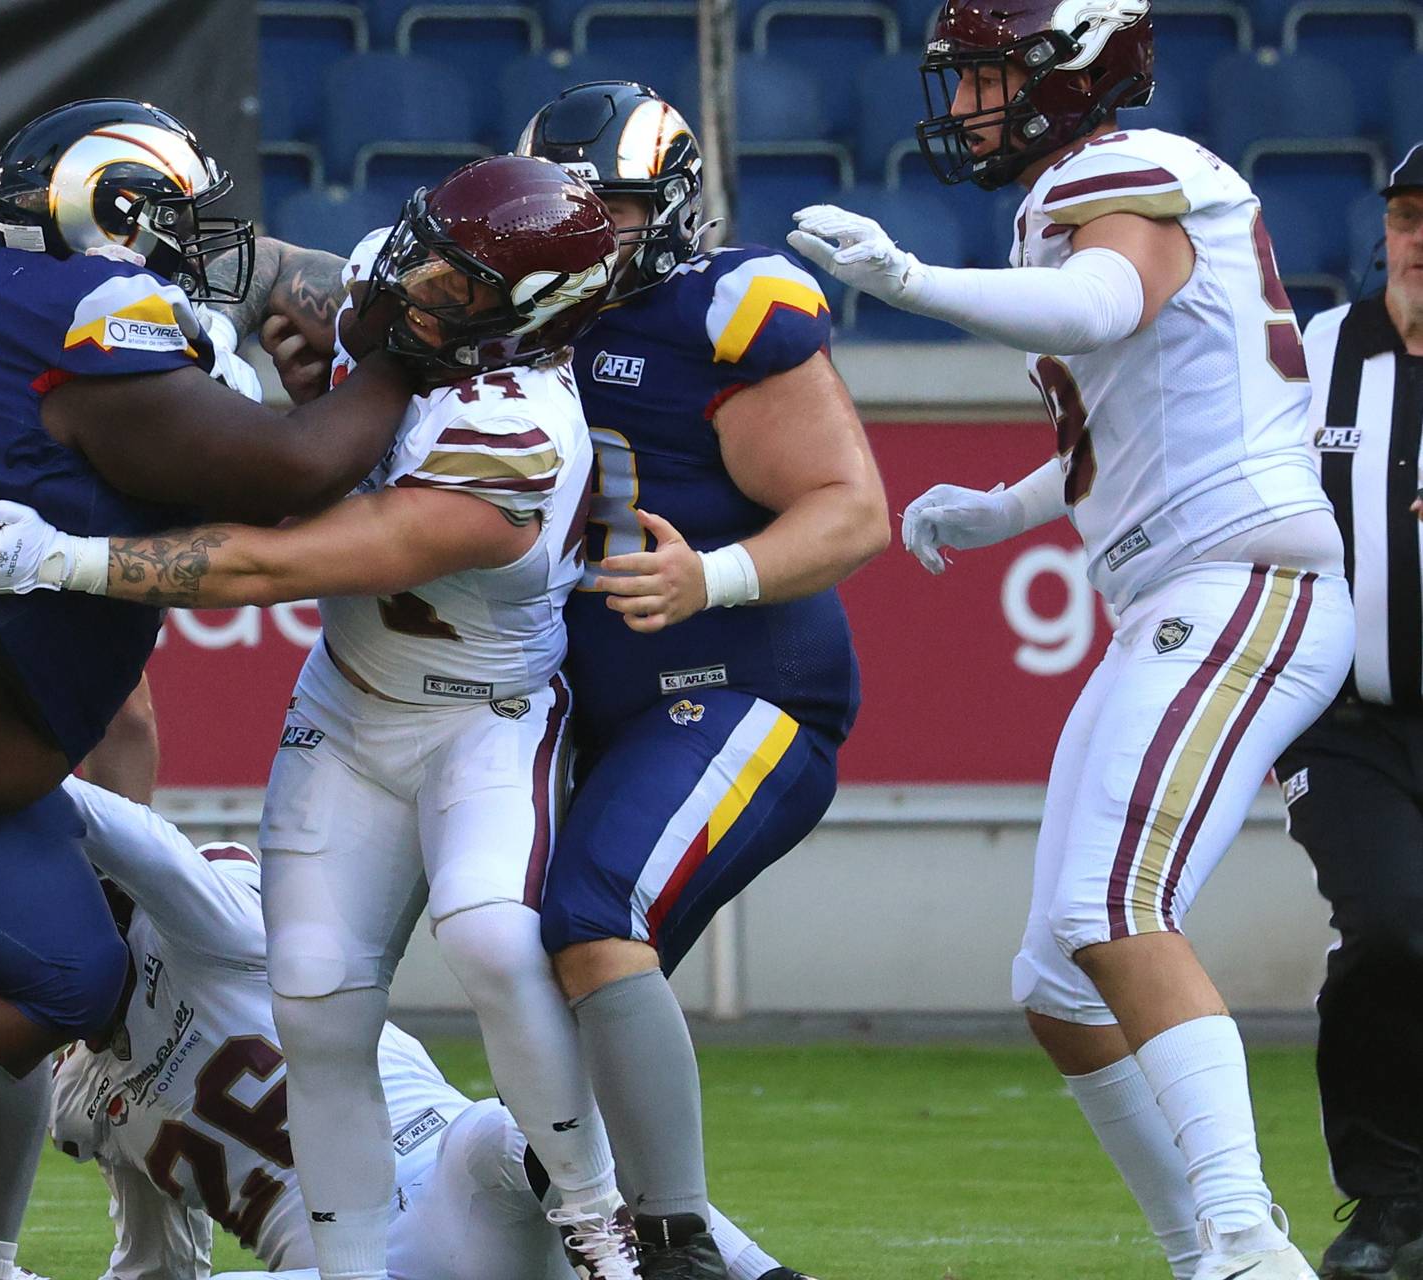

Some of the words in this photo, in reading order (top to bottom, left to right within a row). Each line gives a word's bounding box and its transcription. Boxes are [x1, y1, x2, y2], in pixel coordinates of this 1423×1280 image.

[598, 357, 641, 379] AFLE
[1317, 429, 1361, 447] AFLE
[685, 673, 706, 685] AFLE
[281, 727, 324, 746] AFLE
[410, 1122, 428, 1139] AFLE
